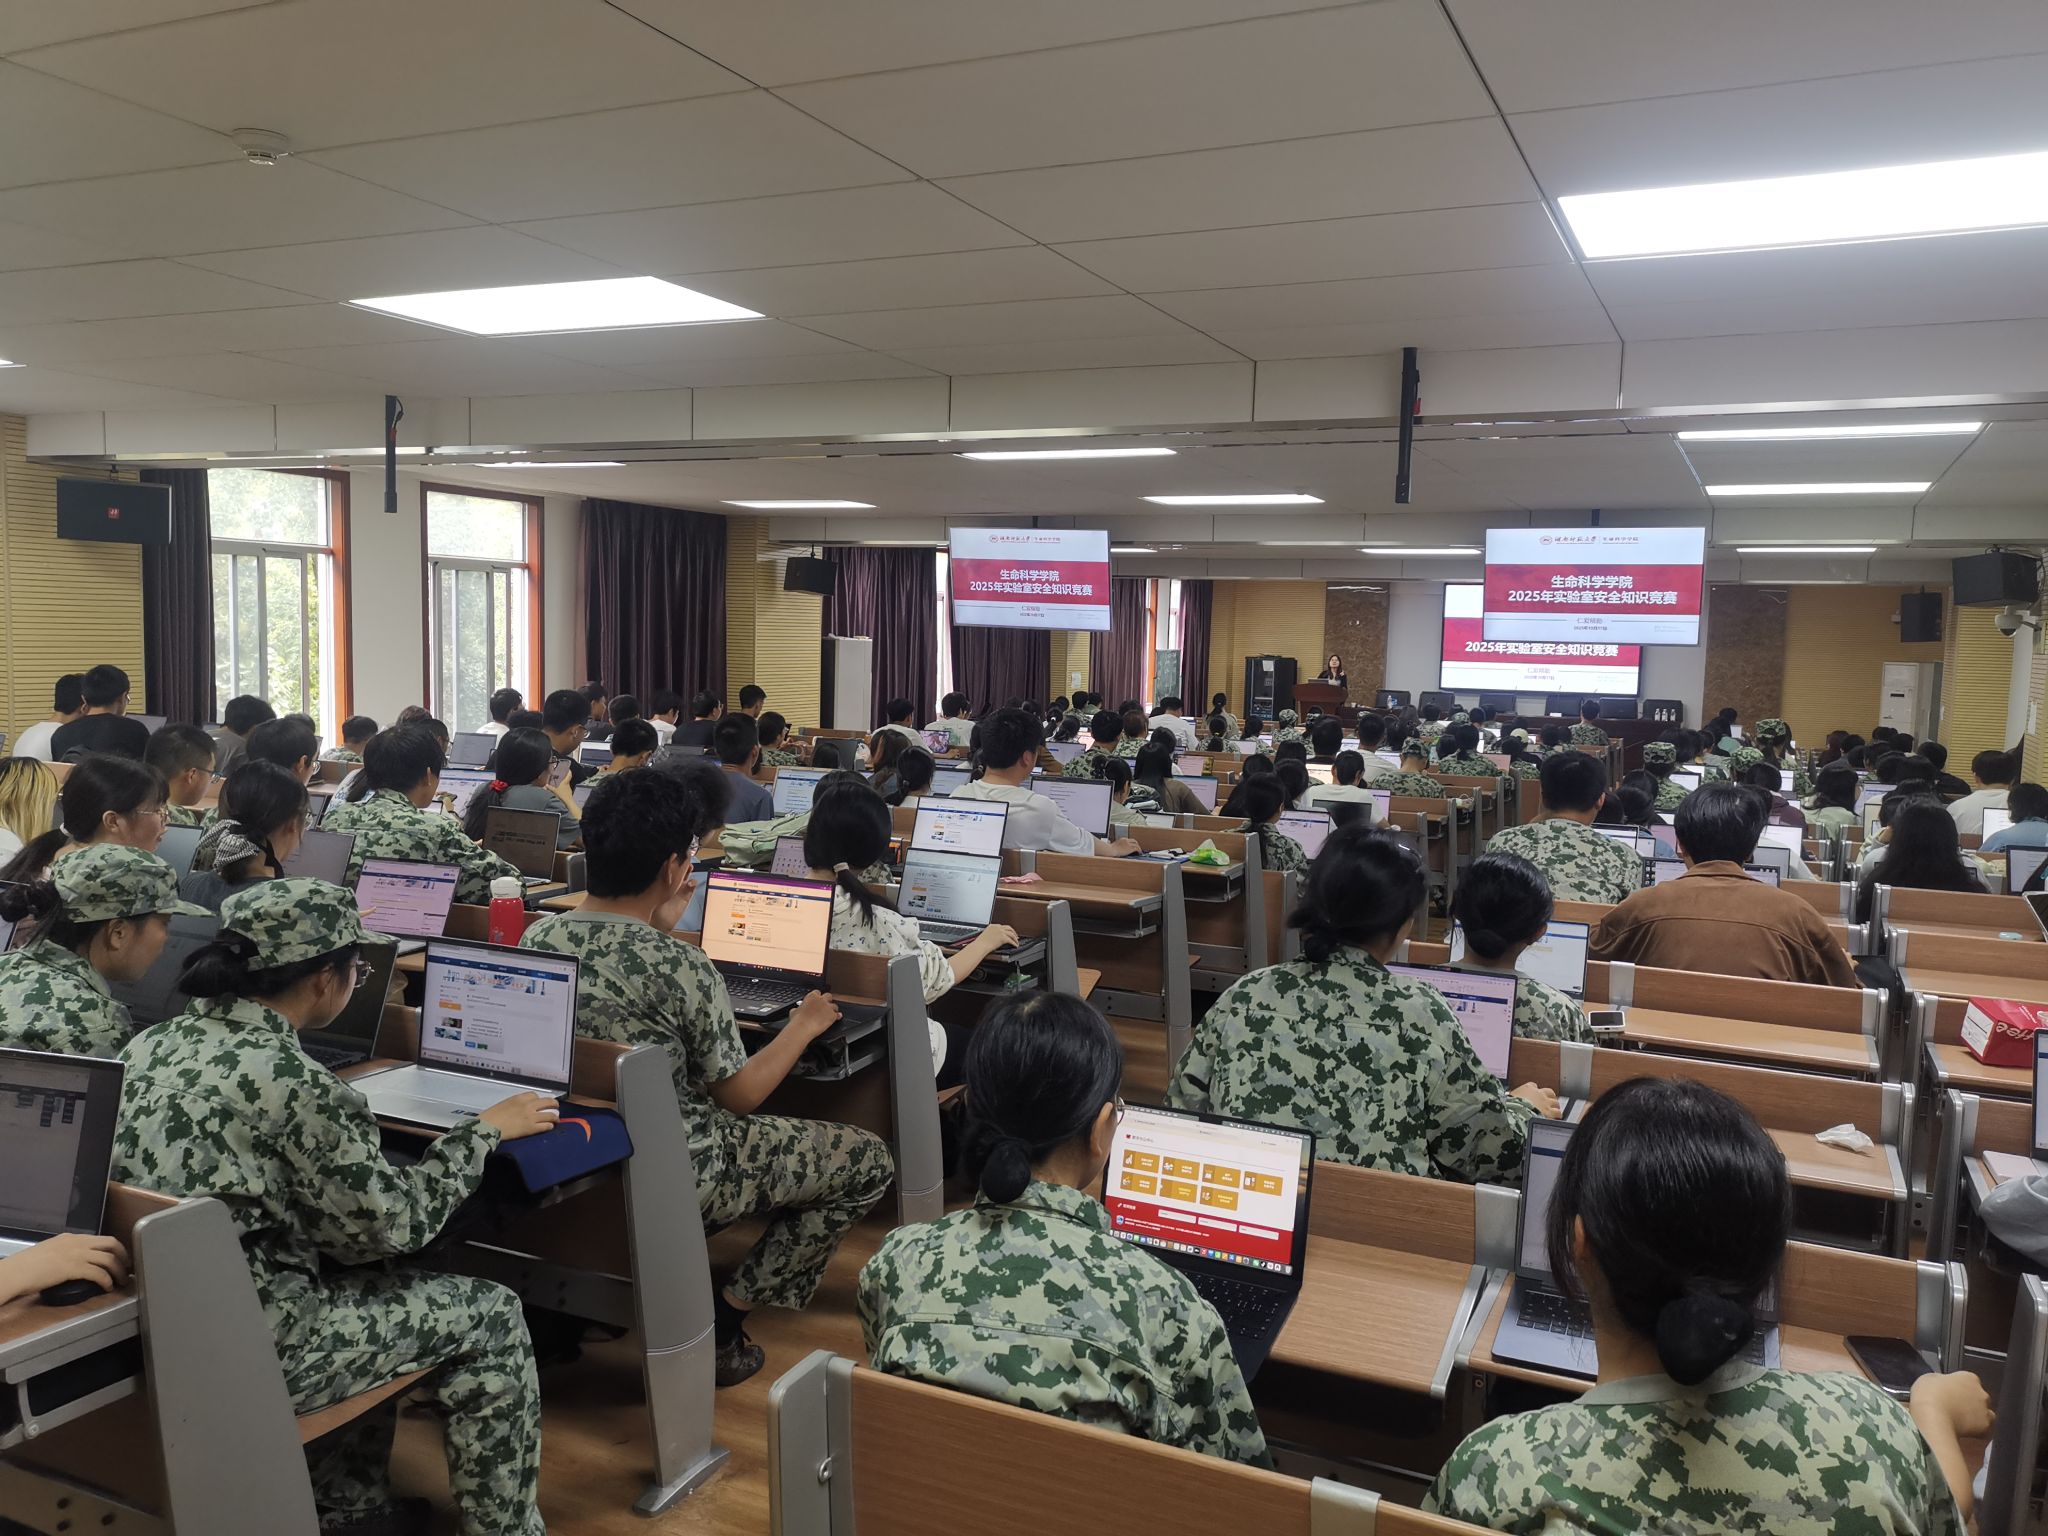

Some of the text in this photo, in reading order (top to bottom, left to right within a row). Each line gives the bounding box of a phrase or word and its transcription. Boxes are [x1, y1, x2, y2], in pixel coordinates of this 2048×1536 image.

[999, 569, 1060, 582] 生命科学学院
[1551, 575, 1633, 589] 生命科学学院
[970, 581, 1093, 596] 2025年实验室安全知识竞赛
[1508, 590, 1678, 605] 2025年实验室安全知识竞赛
[1465, 641, 1619, 658] 2025年实验室安全知识竞赛
[1996, 1021, 2034, 1041] ffee
